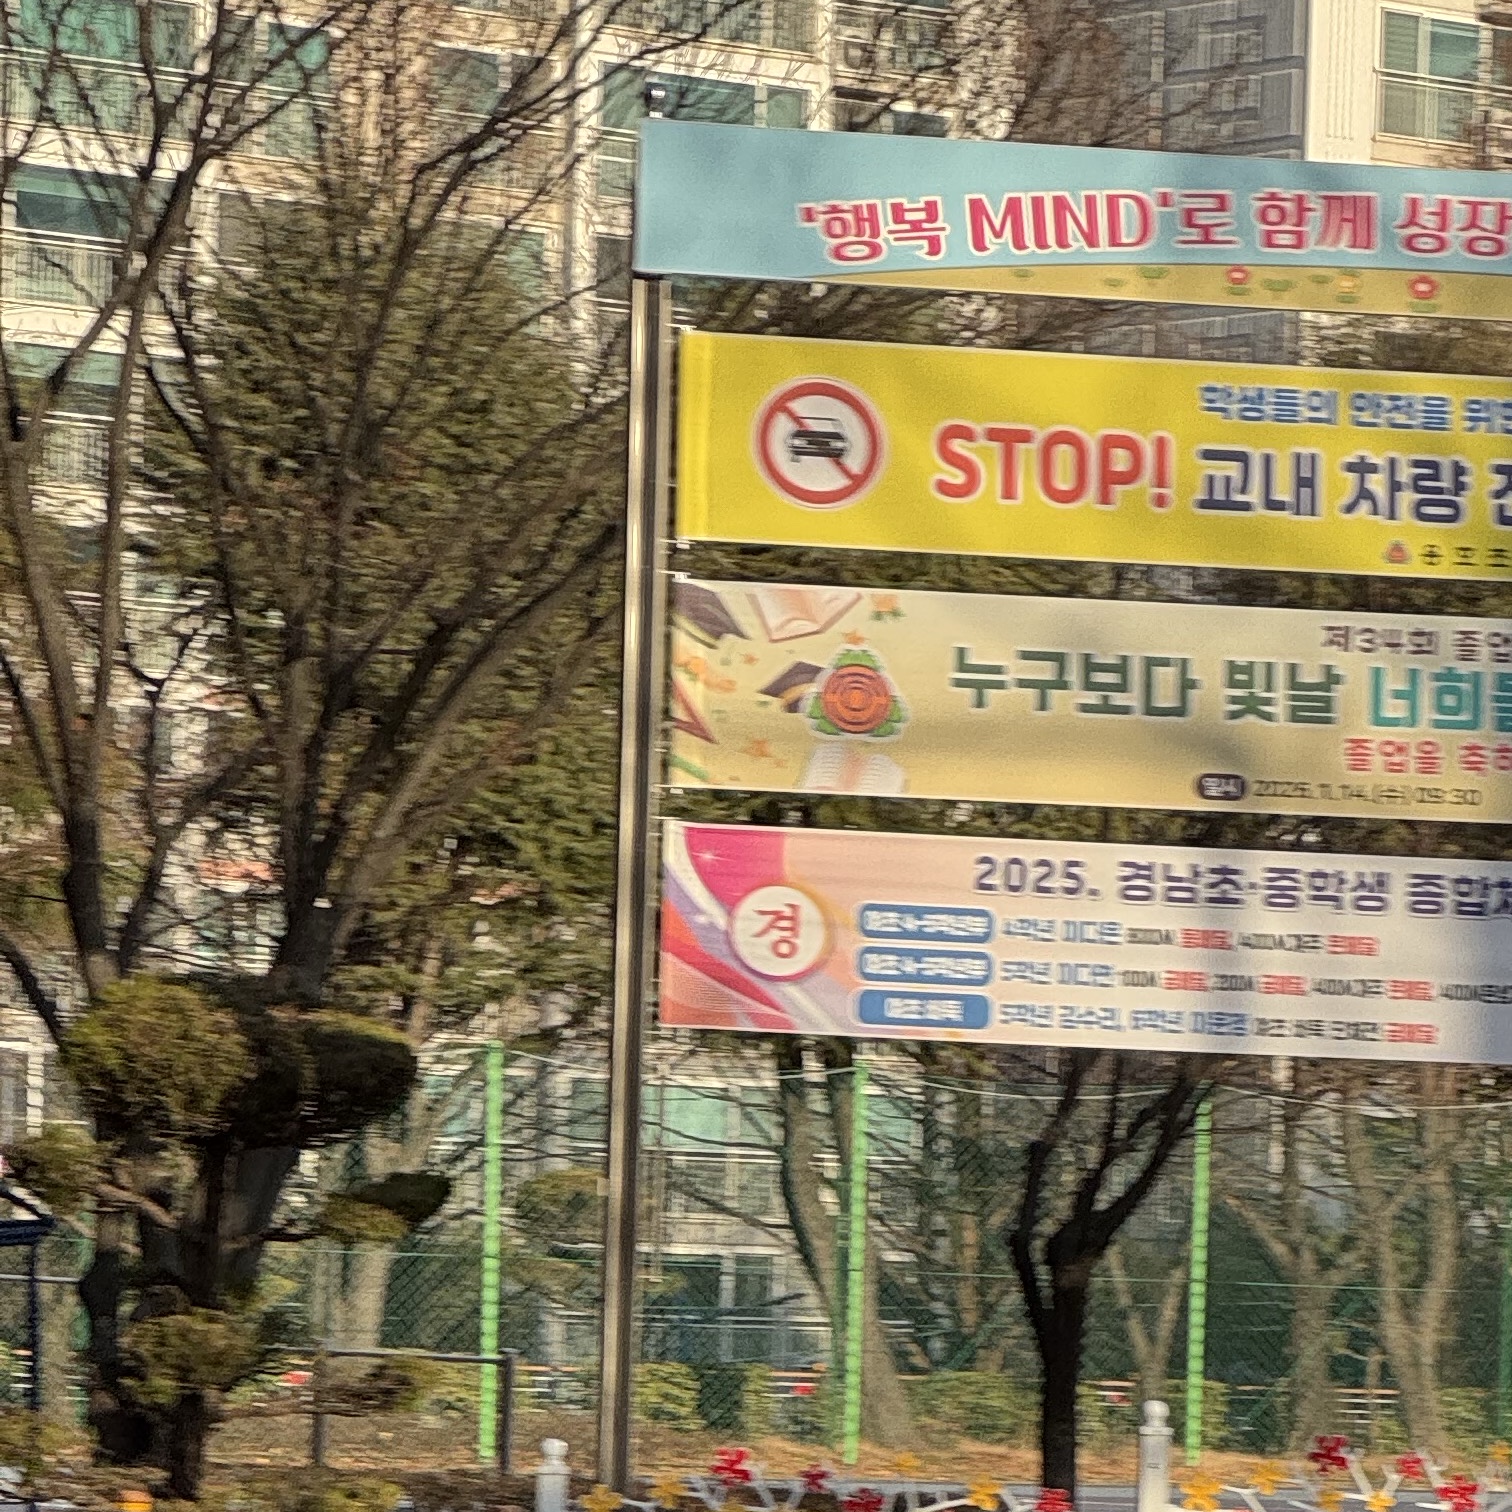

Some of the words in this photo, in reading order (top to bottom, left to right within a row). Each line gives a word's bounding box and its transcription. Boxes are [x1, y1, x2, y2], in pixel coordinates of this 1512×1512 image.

[802, 197, 947, 261] '행복
[970, 190, 1240, 250] MIND'로
[1256, 191, 1376, 251] 함께
[1200, 386, 1338, 425] 학생들의
[1349, 392, 1450, 431] 안전을
[936, 423, 1171, 509] STOP!
[1198, 448, 1319, 516] 교내
[1343, 455, 1472, 524] 차량
[1321, 625, 1440, 656] 제34회
[950, 646, 1200, 718] 누구보다
[1225, 660, 1343, 724] 빛날
[1343, 738, 1446, 774] 졸업을
[1206, 778, 1238, 797] 일시
[1415, 786, 1481, 806] 09:30
[974, 856, 1101, 897] 2025.
[753, 903, 799, 959] 경
